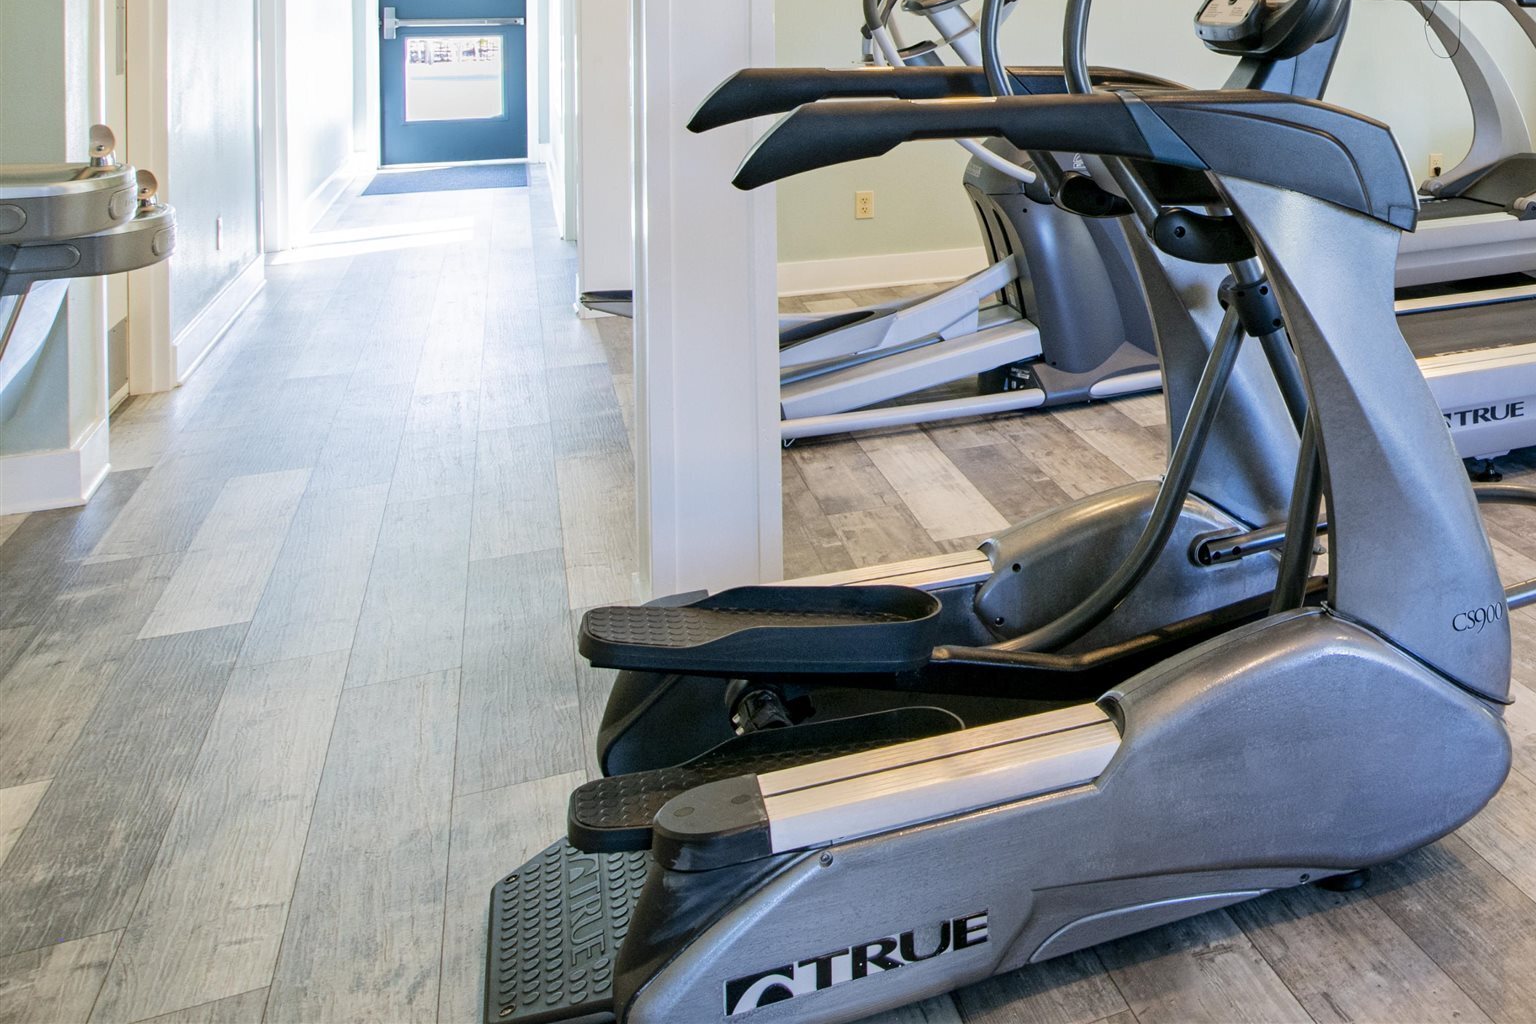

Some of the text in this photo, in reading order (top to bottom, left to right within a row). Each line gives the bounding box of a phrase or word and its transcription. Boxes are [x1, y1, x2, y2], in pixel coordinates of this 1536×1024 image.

[1454, 401, 1525, 426] TRUE
[1452, 601, 1503, 634] CS900
[569, 872, 606, 965] TRUE
[797, 907, 989, 992] TRUE
